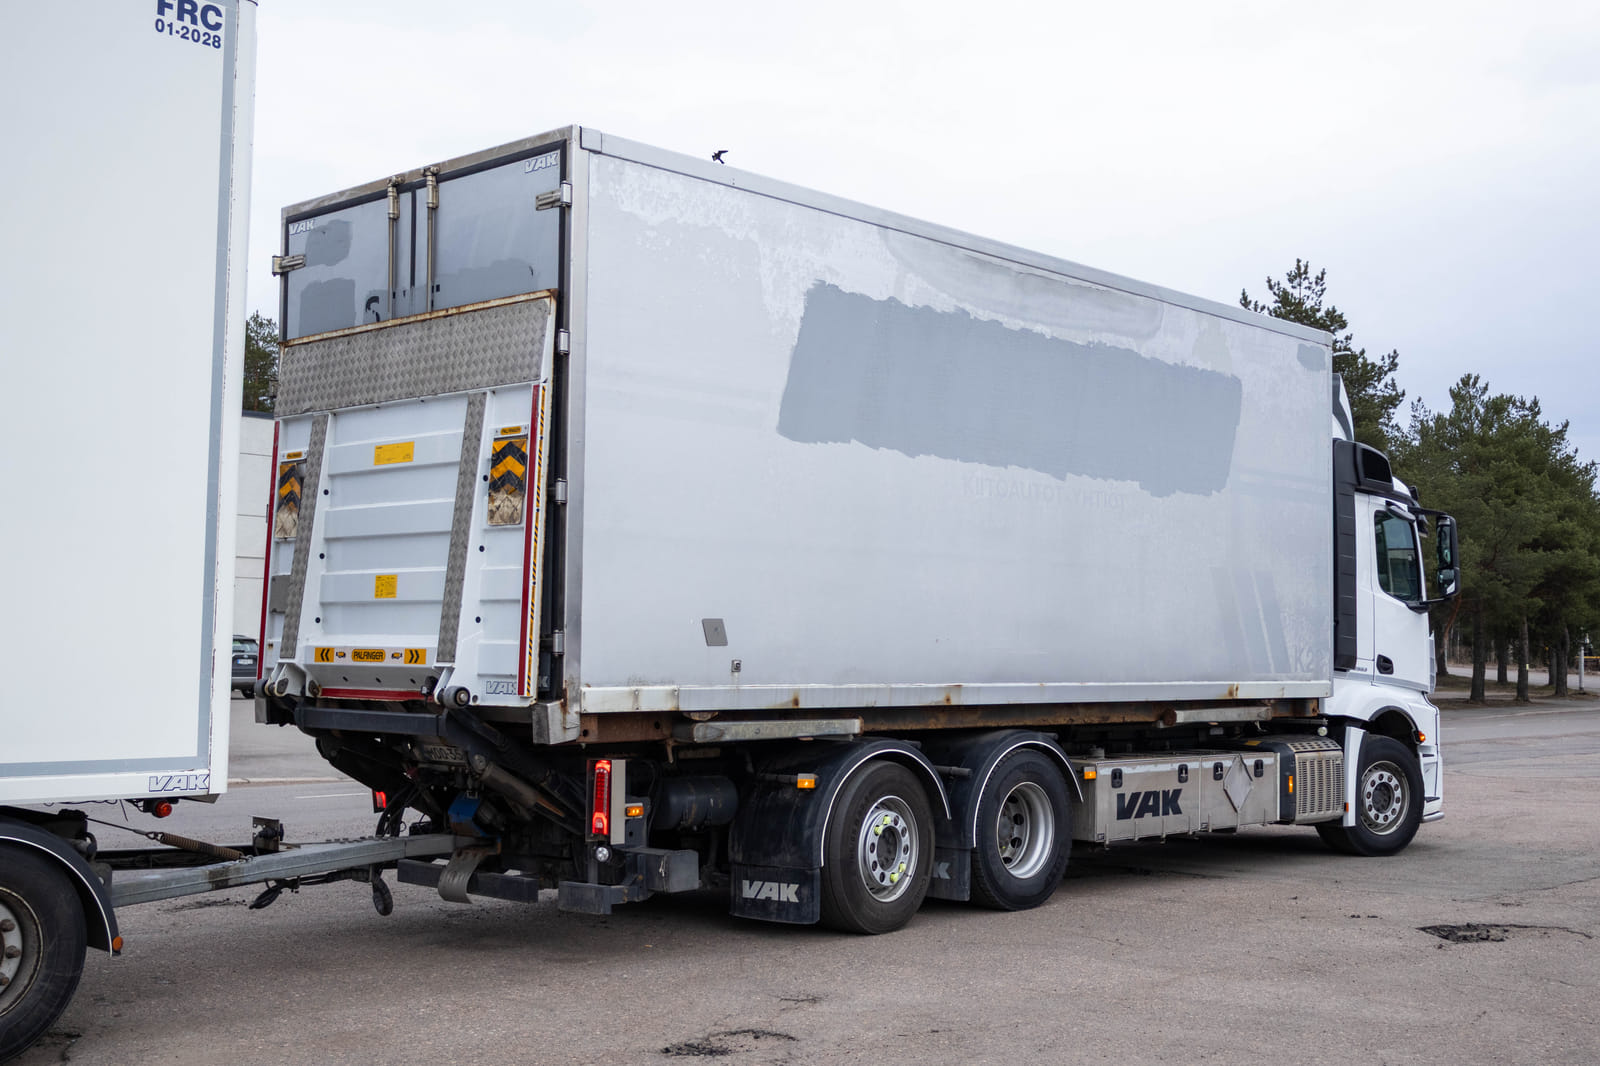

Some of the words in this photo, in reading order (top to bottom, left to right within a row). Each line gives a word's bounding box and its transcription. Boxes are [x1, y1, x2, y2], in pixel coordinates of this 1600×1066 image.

[157, 0, 223, 31] FRC
[155, 18, 221, 49] 01-2028
[524, 152, 559, 174] VAK
[289, 219, 315, 235] VAK
[486, 680, 518, 695] VAK
[149, 774, 209, 792] VAK
[1116, 788, 1183, 820] VAK
[742, 880, 799, 903] VAK
